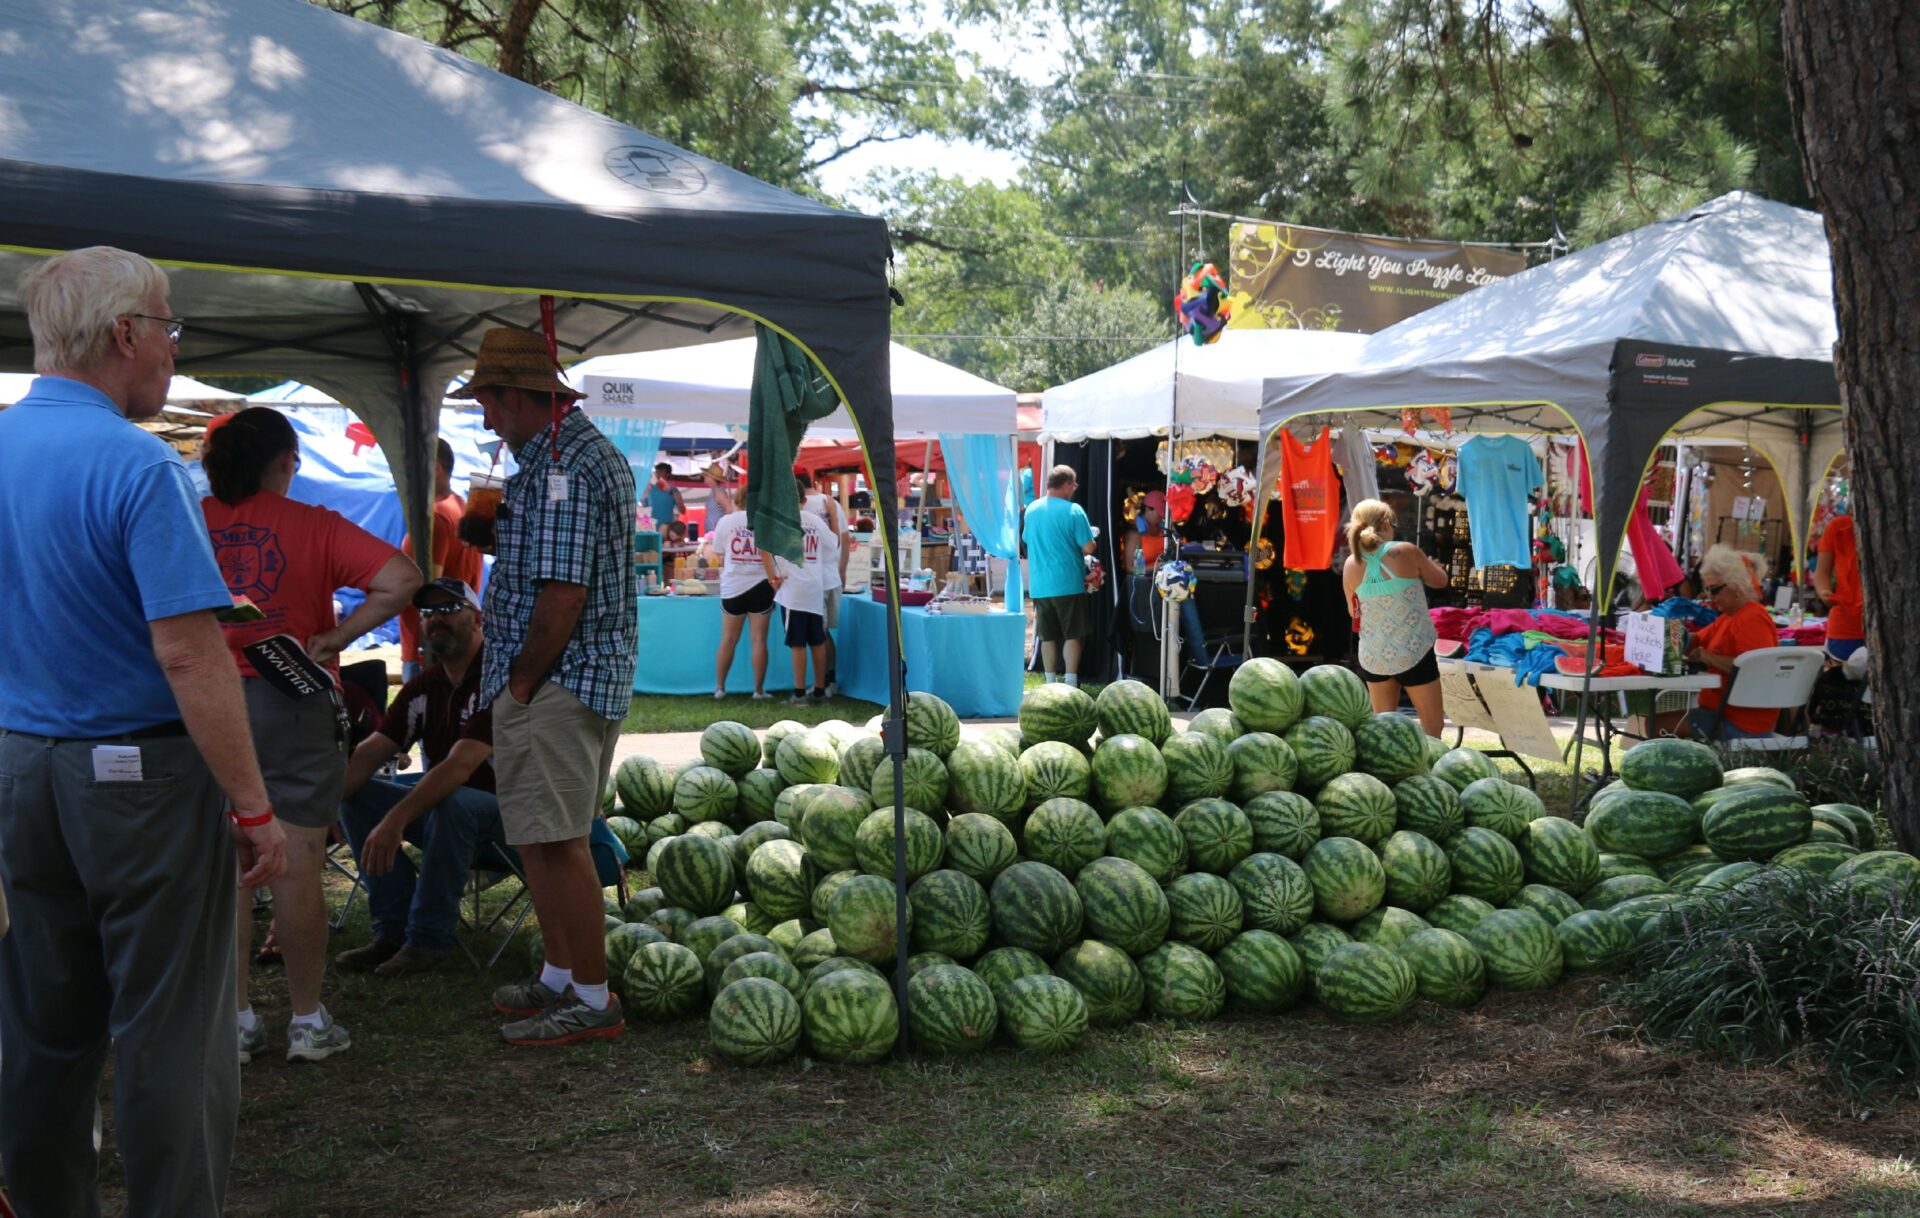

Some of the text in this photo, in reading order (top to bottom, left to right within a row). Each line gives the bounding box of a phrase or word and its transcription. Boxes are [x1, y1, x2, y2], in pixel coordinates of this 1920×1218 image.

[1315, 250, 1366, 276] Light
[1368, 255, 1402, 280] You
[1405, 258, 1464, 289] Puzzle
[1667, 358, 1696, 368] MAX
[602, 382, 634, 394] QUIK
[602, 393, 635, 404] SHADE
[222, 531, 255, 543] MIZE
[736, 529, 753, 538] KEN
[257, 644, 314, 694] SULLIVAN
